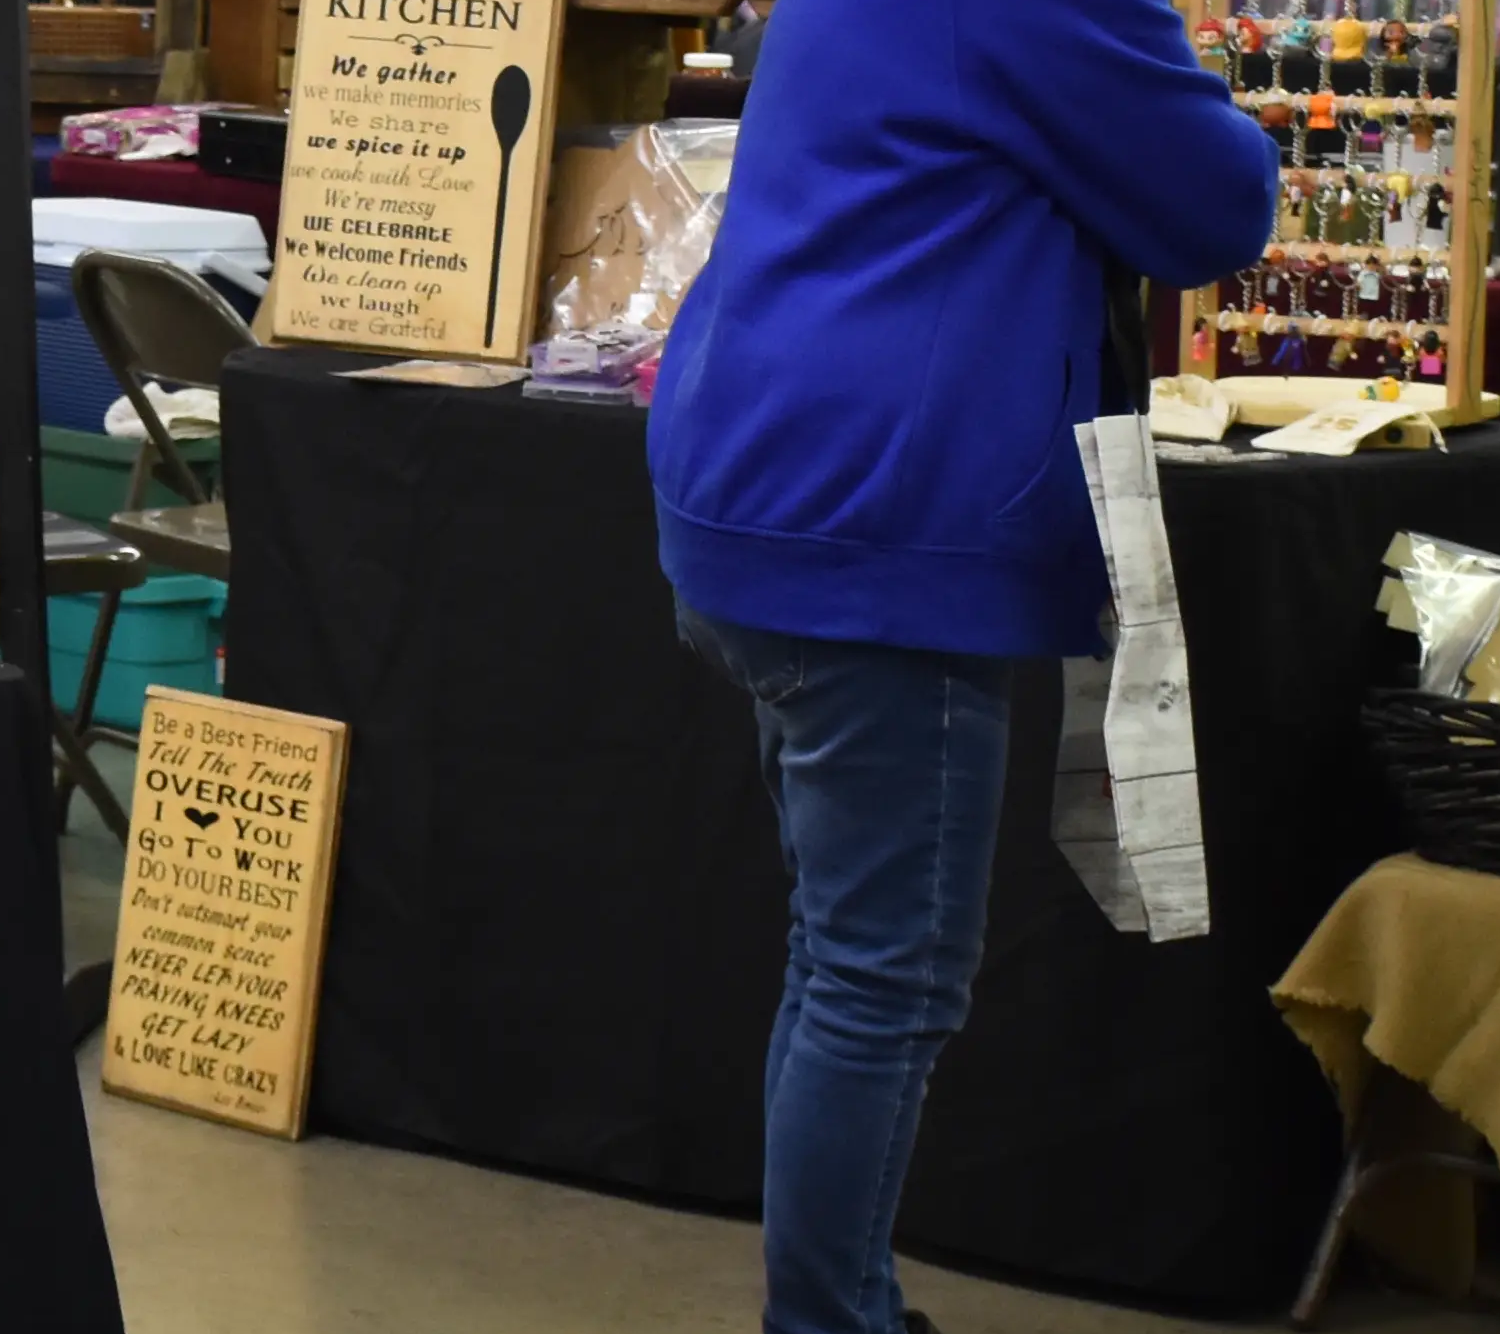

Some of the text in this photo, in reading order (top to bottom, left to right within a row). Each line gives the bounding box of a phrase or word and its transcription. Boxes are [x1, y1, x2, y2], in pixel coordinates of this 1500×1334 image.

[331, 55, 458, 85] We gather
[334, 84, 383, 106] make
[390, 88, 482, 114] memories
[329, 109, 450, 136] We share
[307, 134, 467, 165] we spice it up
[320, 160, 475, 194] cook with Love
[325, 188, 436, 220] We're messy
[303, 214, 334, 233] WE
[284, 236, 468, 273] We Welcome Friends
[302, 264, 442, 300] We clean up
[320, 292, 420, 318] we laugh
[291, 309, 446, 341] We are Grateful
[153, 712, 319, 763] Be a Best Friend
[148, 740, 314, 792] Tell The Truth
[146, 768, 311, 824] OVERUSE
[153, 800, 164, 821] I
[138, 828, 173, 854] Go
[184, 836, 222, 861] To
[137, 857, 299, 913] DO YOUR BEST
[141, 923, 215, 956] common
[124, 947, 189, 978] NEVER
[231, 968, 289, 1003] YOUR
[120, 974, 286, 1033] PRAYING KNEES
[140, 1012, 253, 1056] GET LAZY
[131, 1038, 279, 1096] LOVE LIKE CRAZY
